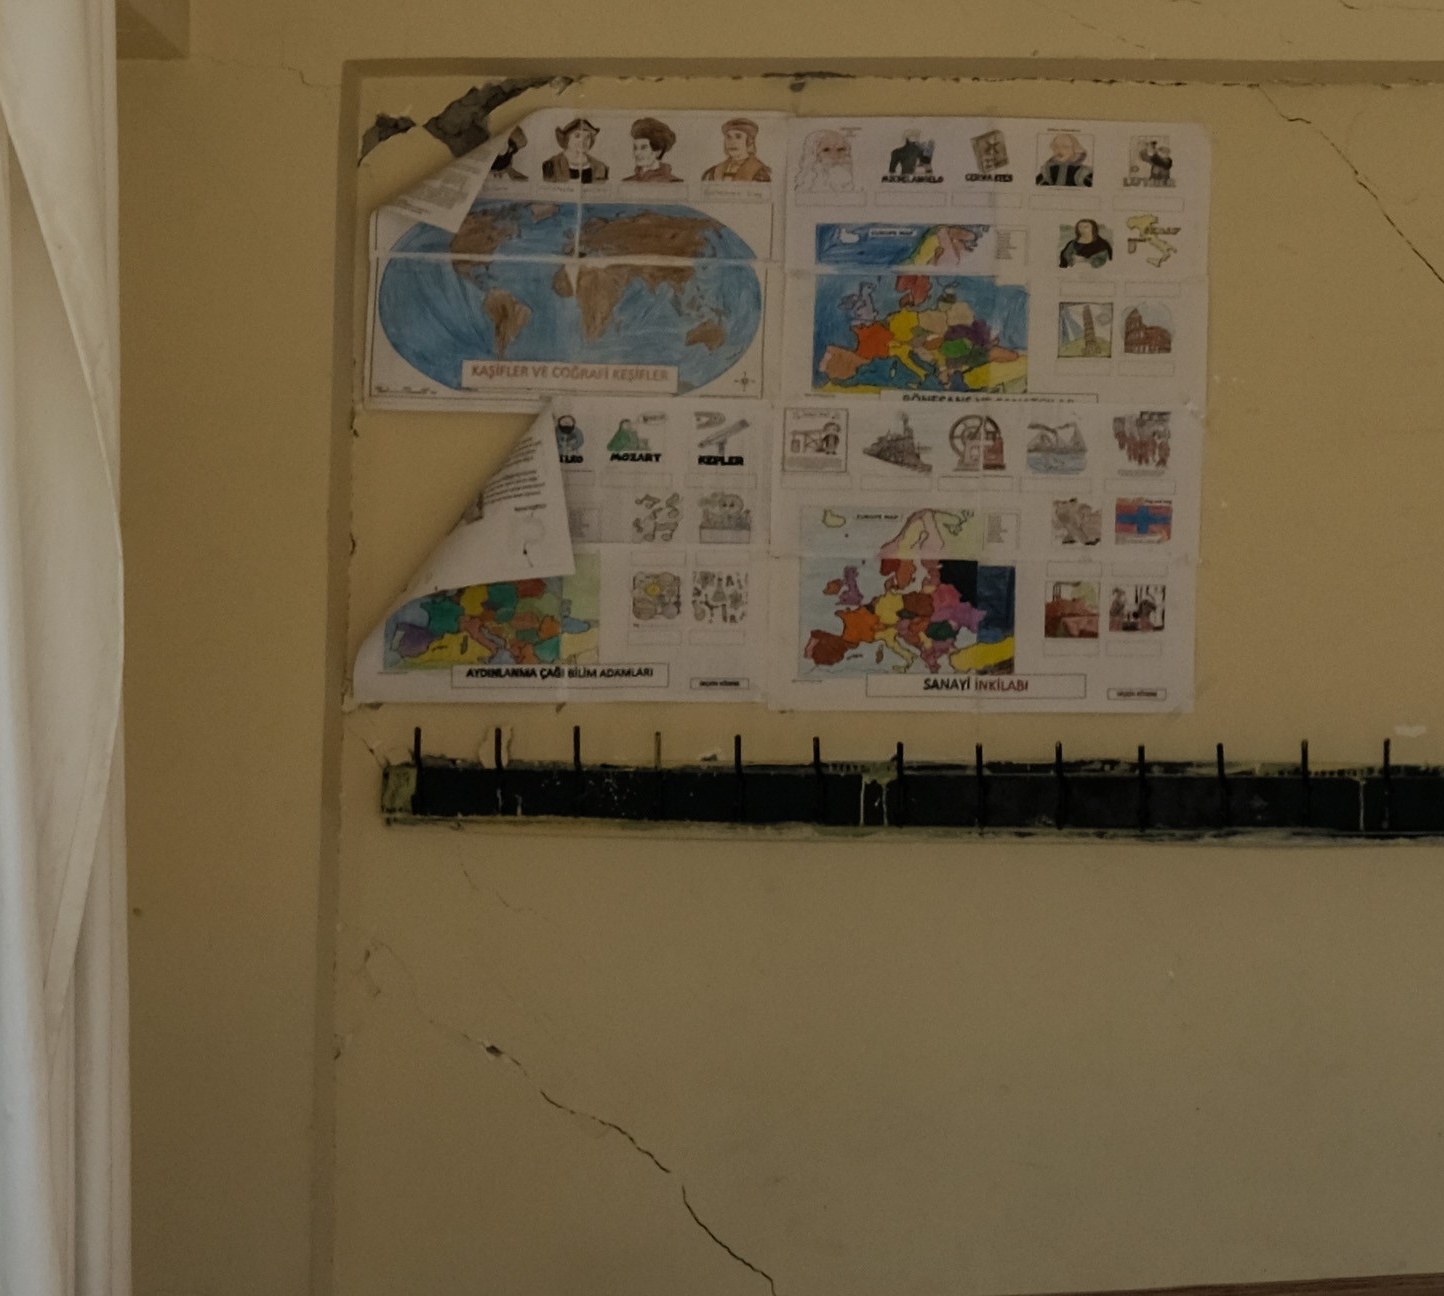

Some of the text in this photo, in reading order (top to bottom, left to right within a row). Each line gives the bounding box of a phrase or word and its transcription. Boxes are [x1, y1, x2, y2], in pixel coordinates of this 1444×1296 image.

[471, 364, 669, 382] KAŞİFLER VE COĞRAFİ KEŞİFLER
[698, 455, 744, 465] KEPLER
[466, 668, 537, 678] AYDINLANMA
[567, 667, 597, 678] BİLİM
[600, 667, 653, 678] ADAMLARI
[923, 677, 971, 690] SANAYİ
